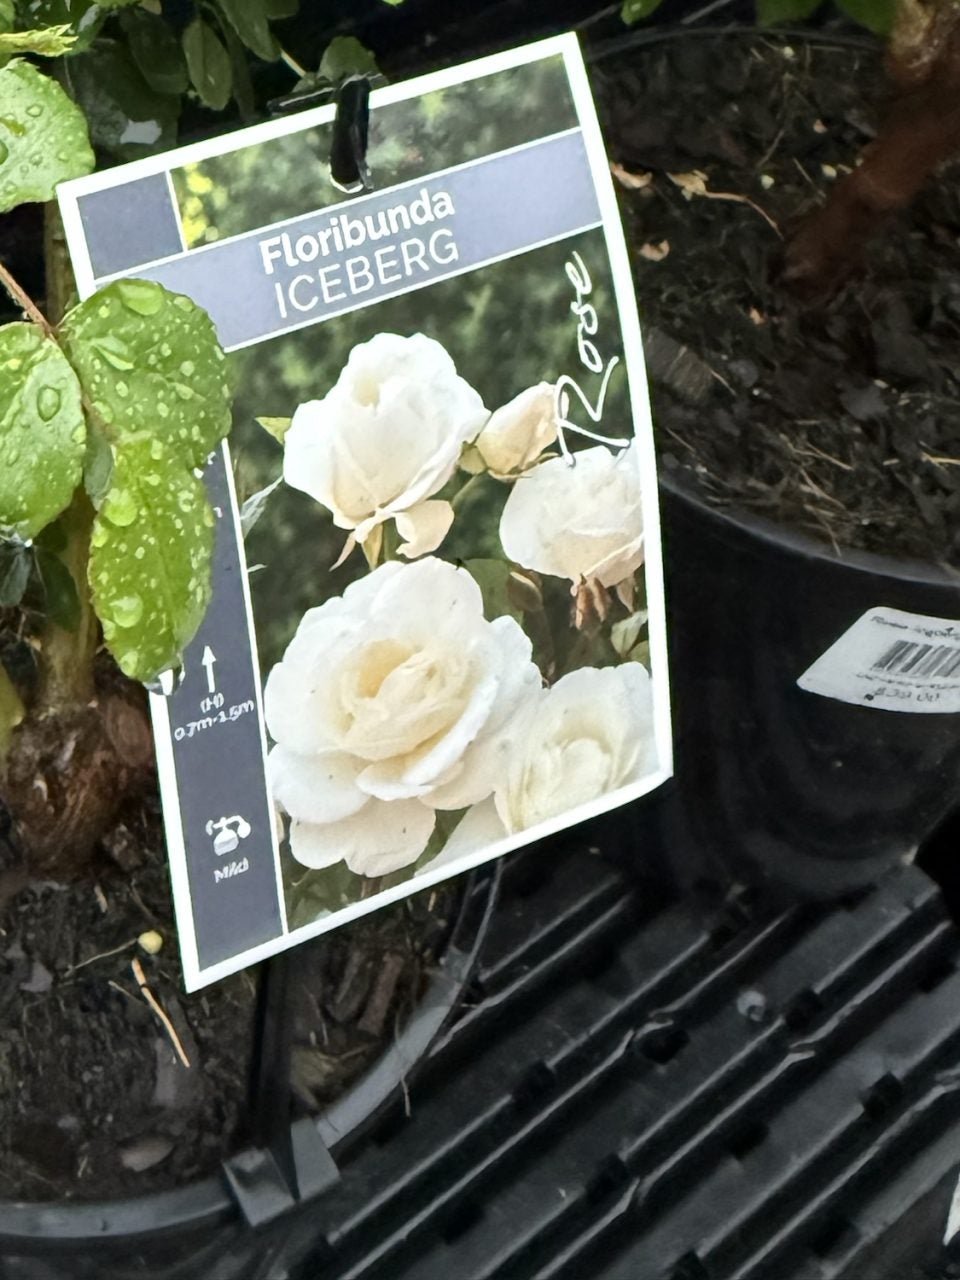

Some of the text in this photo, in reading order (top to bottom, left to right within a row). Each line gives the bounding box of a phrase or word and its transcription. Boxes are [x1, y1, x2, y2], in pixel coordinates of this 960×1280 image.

[259, 188, 455, 274] Floribunda
[274, 229, 458, 318] ICEBERG
[553, 250, 631, 466] Rose
[214, 857, 250, 883] Mild
